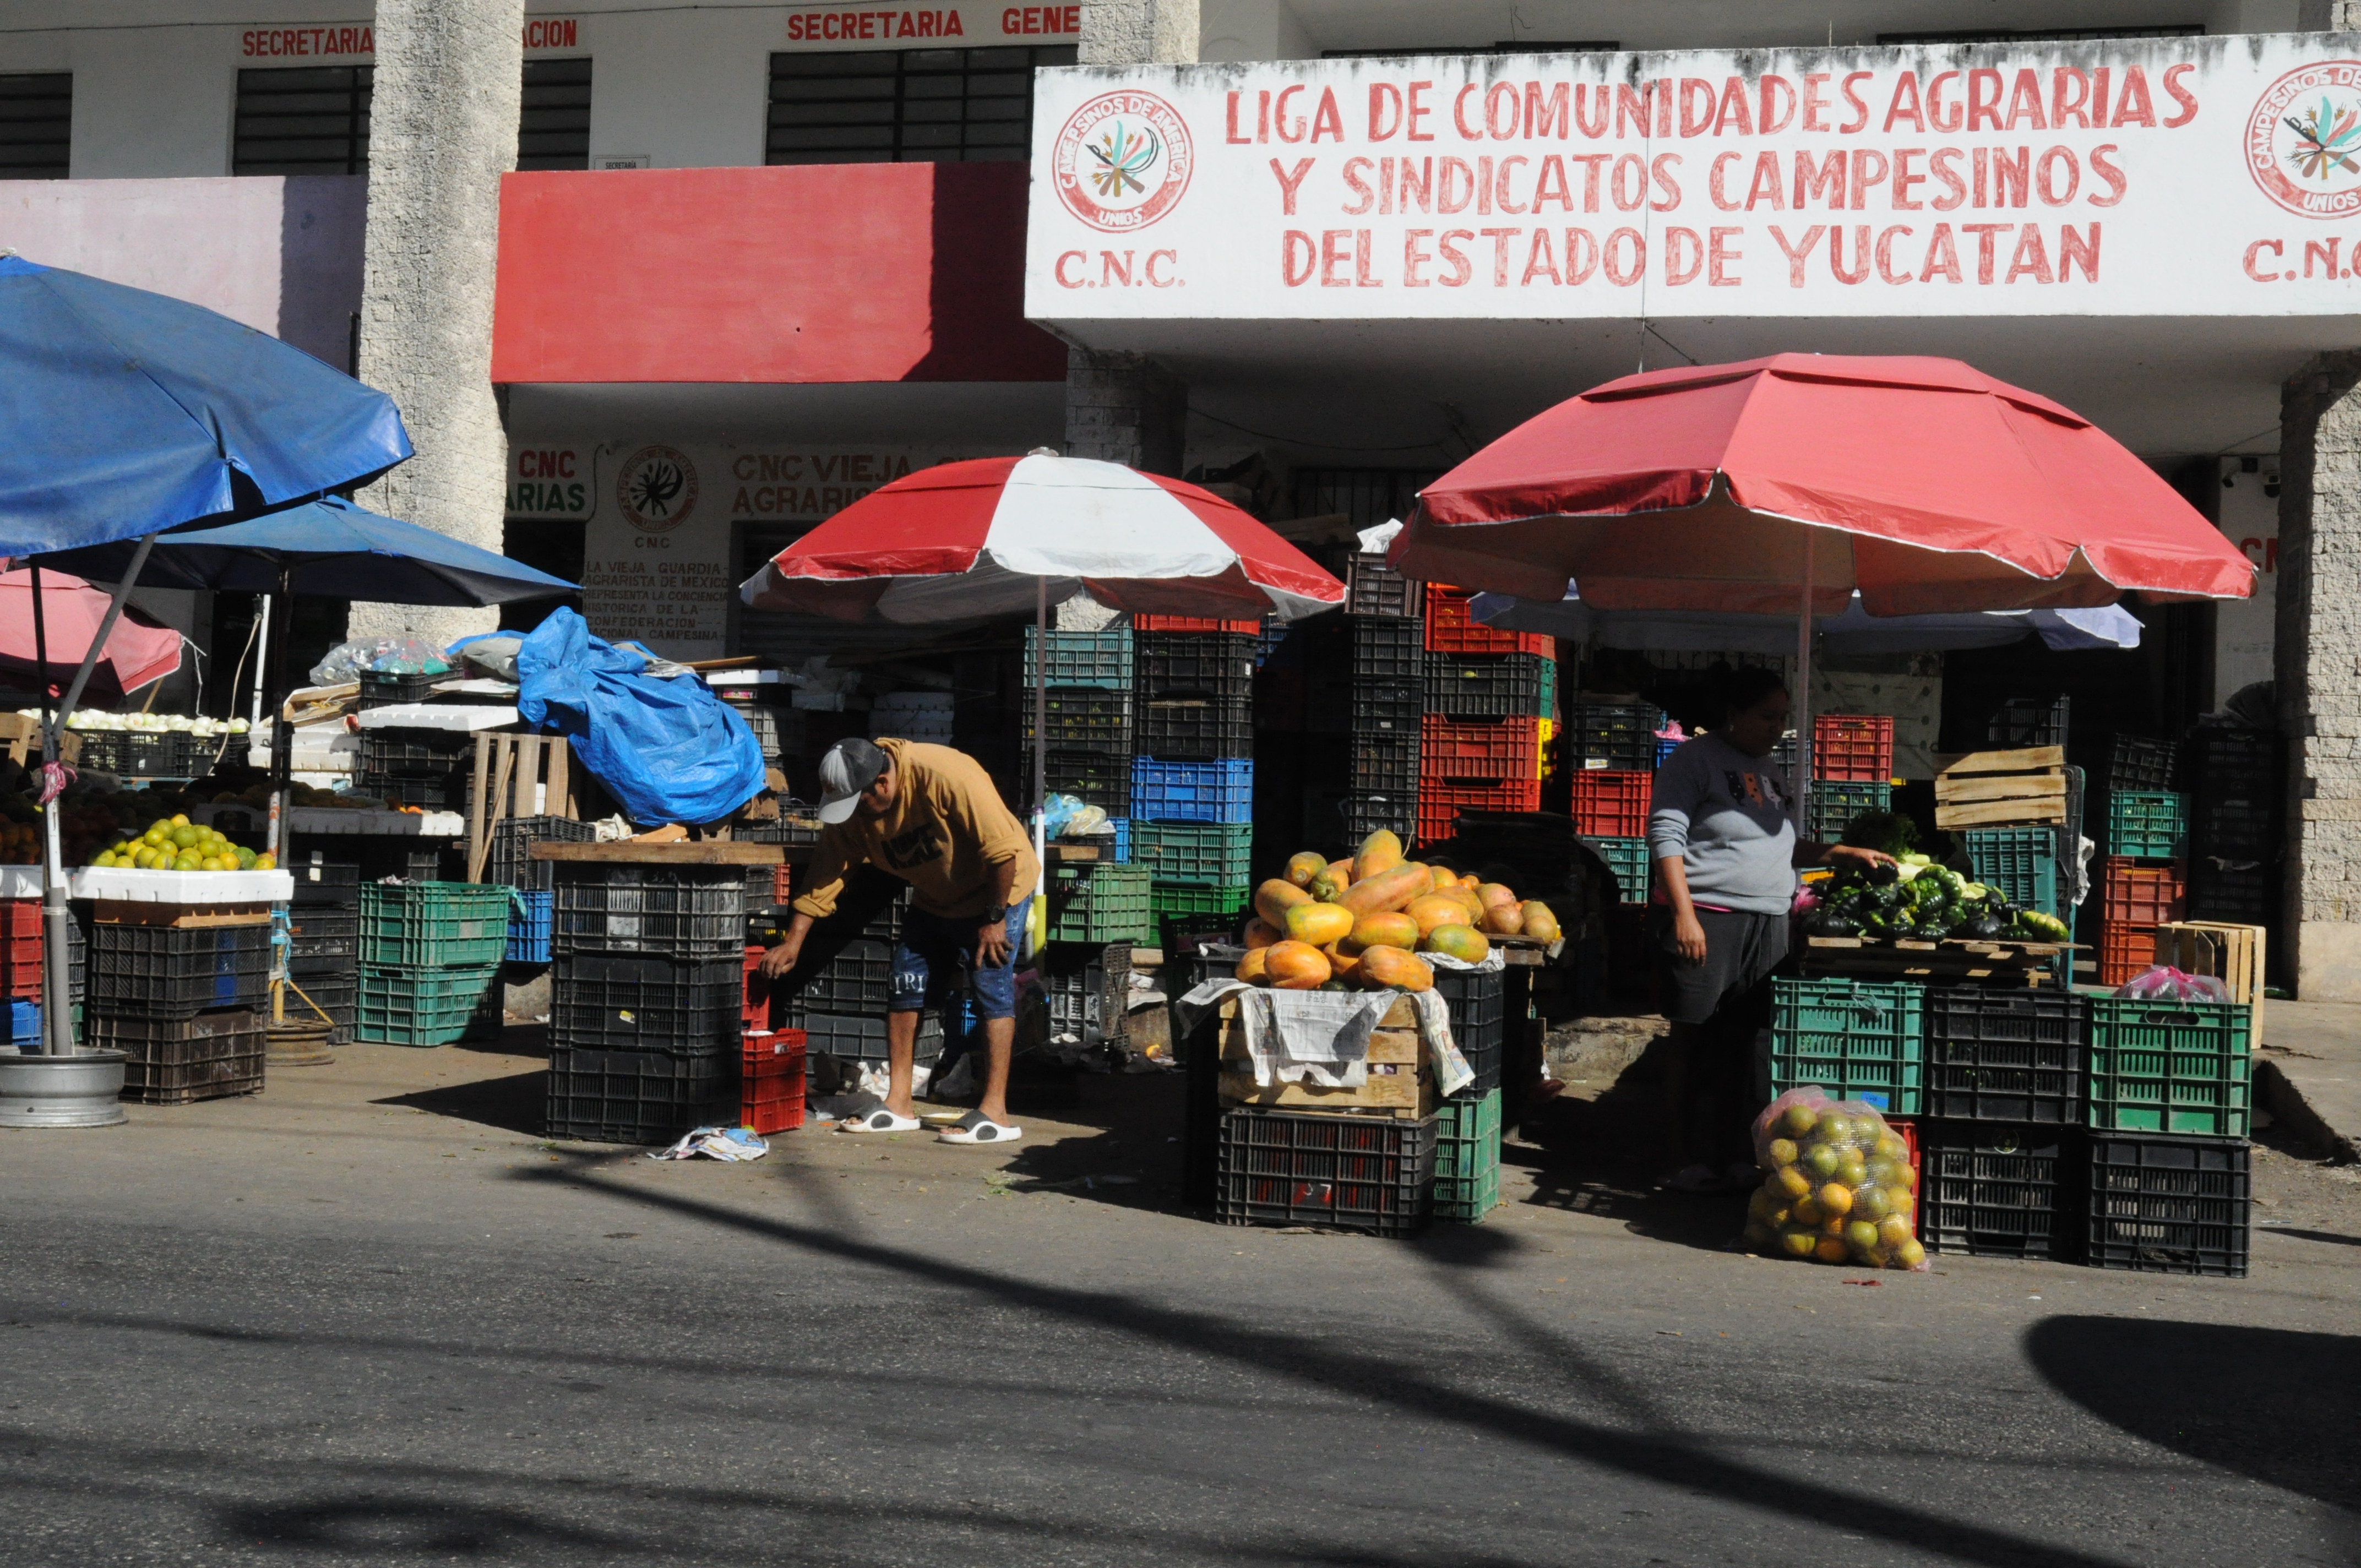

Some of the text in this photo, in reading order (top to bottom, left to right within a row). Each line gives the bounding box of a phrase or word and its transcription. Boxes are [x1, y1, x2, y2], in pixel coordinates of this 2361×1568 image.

[243, 27, 374, 56] SECRETARIA
[788, 6, 1080, 40] SECRETARIA GENE
[1226, 63, 2198, 144] LIGA DE COMUNIDADES AGRARIAS
[2253, 68, 2333, 170] CAMPESINOS
[1128, 97, 1155, 118] DE
[1152, 109, 1187, 183] AMERICA
[1270, 144, 2127, 215] Y SINDICATOS CAMPESINOS
[1054, 249, 1186, 289] C.N.C.
[1283, 222, 2101, 287] DEL ESTADO DE YUCATAN
[2243, 237, 2361, 282] C.N.
[519, 450, 576, 478] CNC
[732, 454, 911, 482] CNC VIEJA
[584, 575, 728, 588] AGRARISTA DE MEXICO
[586, 561, 602, 573] LA
[608, 562, 645, 573] VIEJA
[583, 603, 648, 614] HISTORICA
[656, 605, 674, 614] DE
[584, 589, 649, 601] REPRESENTA
[652, 591, 665, 601] LA
[881, 823, 943, 870] NIKE
